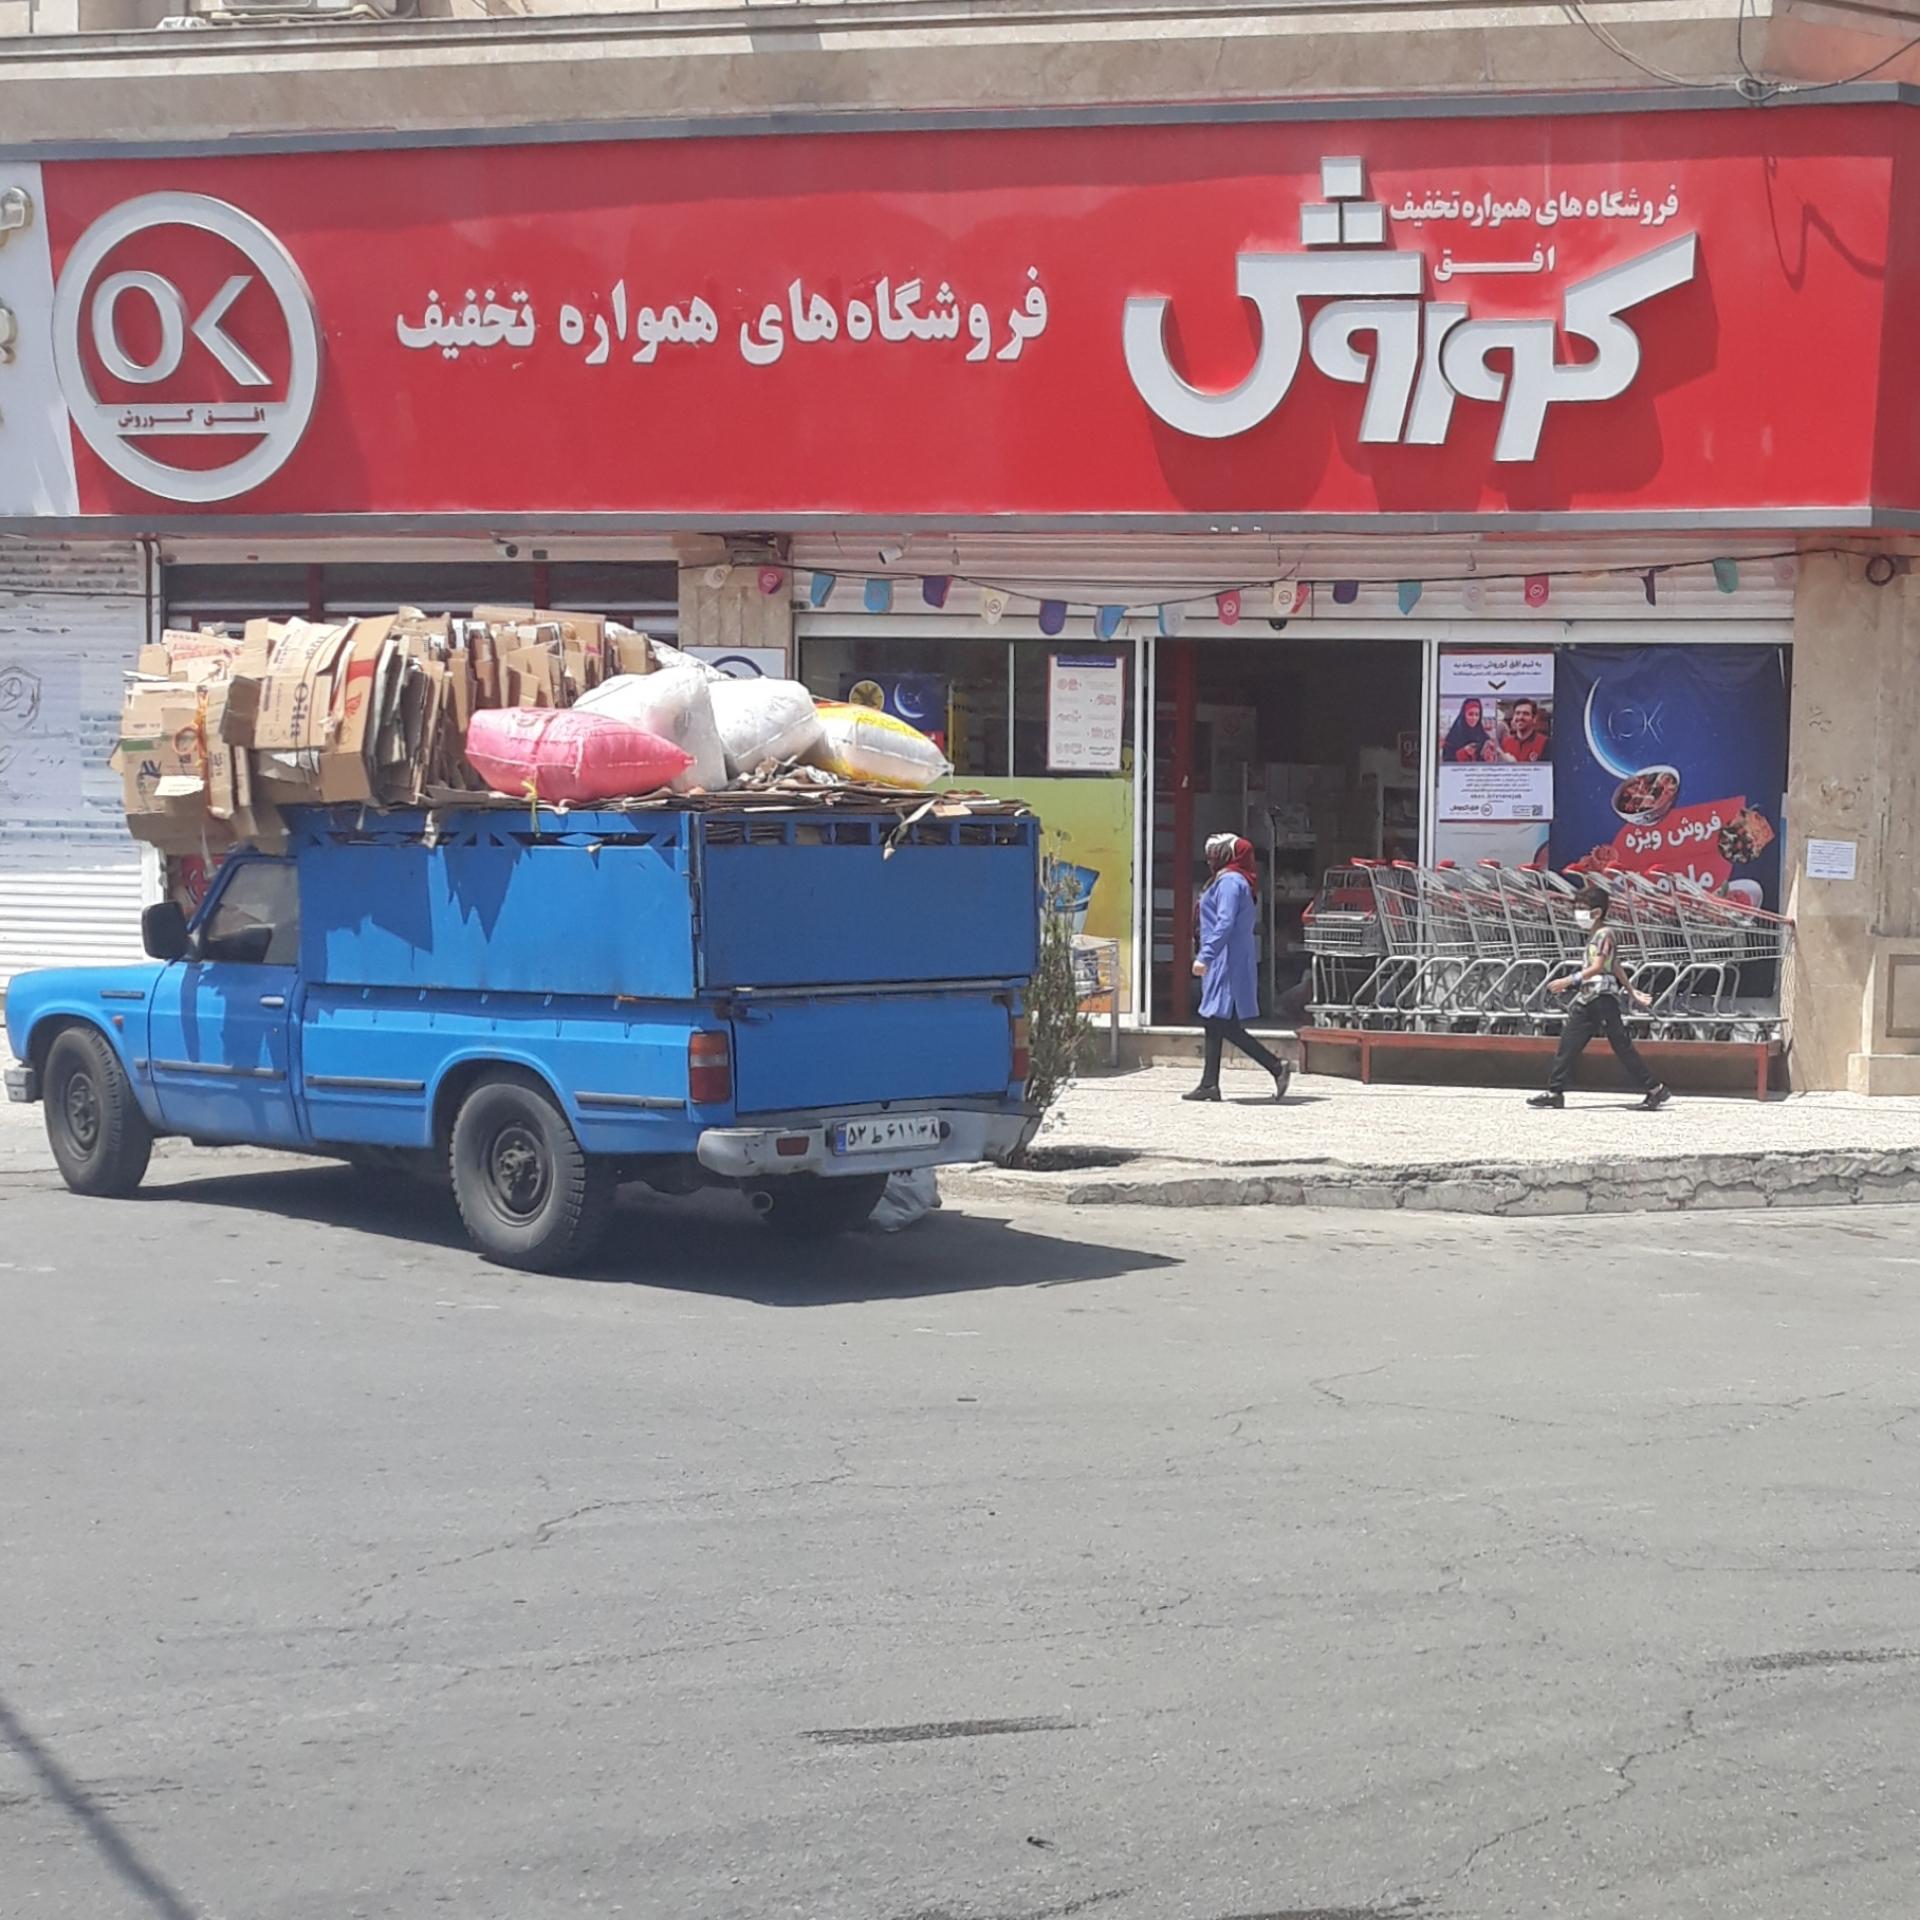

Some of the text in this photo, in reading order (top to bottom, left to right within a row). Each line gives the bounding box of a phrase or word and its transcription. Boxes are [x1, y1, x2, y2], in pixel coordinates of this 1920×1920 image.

[1389, 190, 1460, 227] تخفیف
[1461, 191, 1532, 228] همواره
[91, 270, 273, 386] OK
[396, 288, 536, 359] تخفیف
[558, 278, 719, 365] همواره
[1122, 155, 1696, 463] کوروش
[118, 407, 266, 428] افق کوروش
[1625, 810, 1722, 854] فروش ویژه
